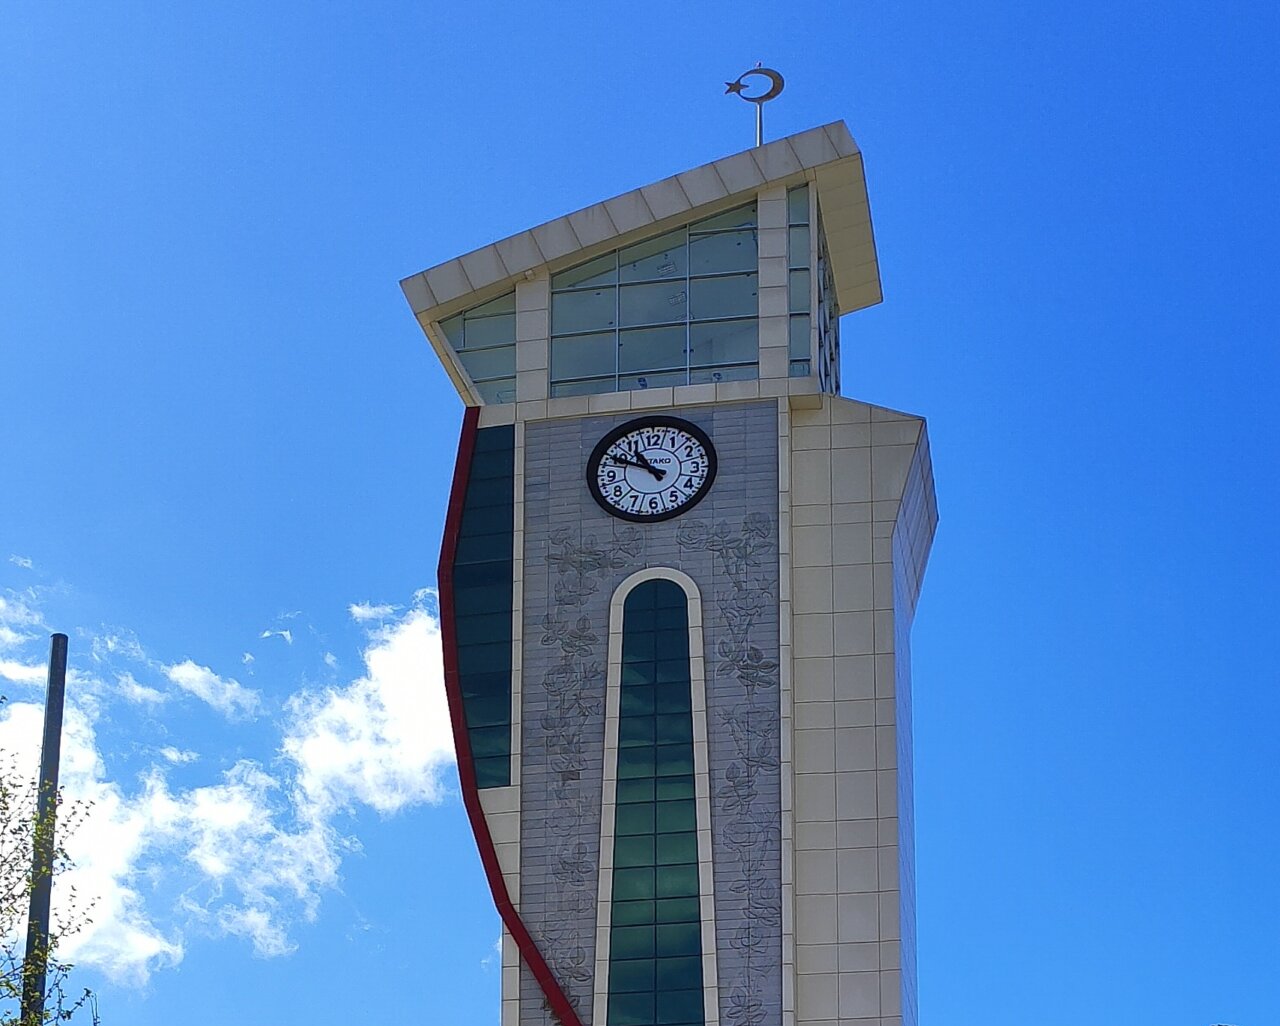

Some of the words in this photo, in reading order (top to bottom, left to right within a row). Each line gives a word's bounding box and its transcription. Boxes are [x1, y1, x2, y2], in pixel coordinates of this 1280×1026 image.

[626, 440, 639, 453] 11
[645, 434, 660, 447] 12
[669, 436, 676, 448] 1
[684, 446, 693, 457] 2
[690, 461, 699, 473] 3
[606, 470, 616, 482] 9
[683, 477, 694, 489] 4
[613, 485, 622, 497] 8
[669, 491, 678, 502] 5
[630, 495, 639, 508] 7
[648, 497, 658, 509] 6
